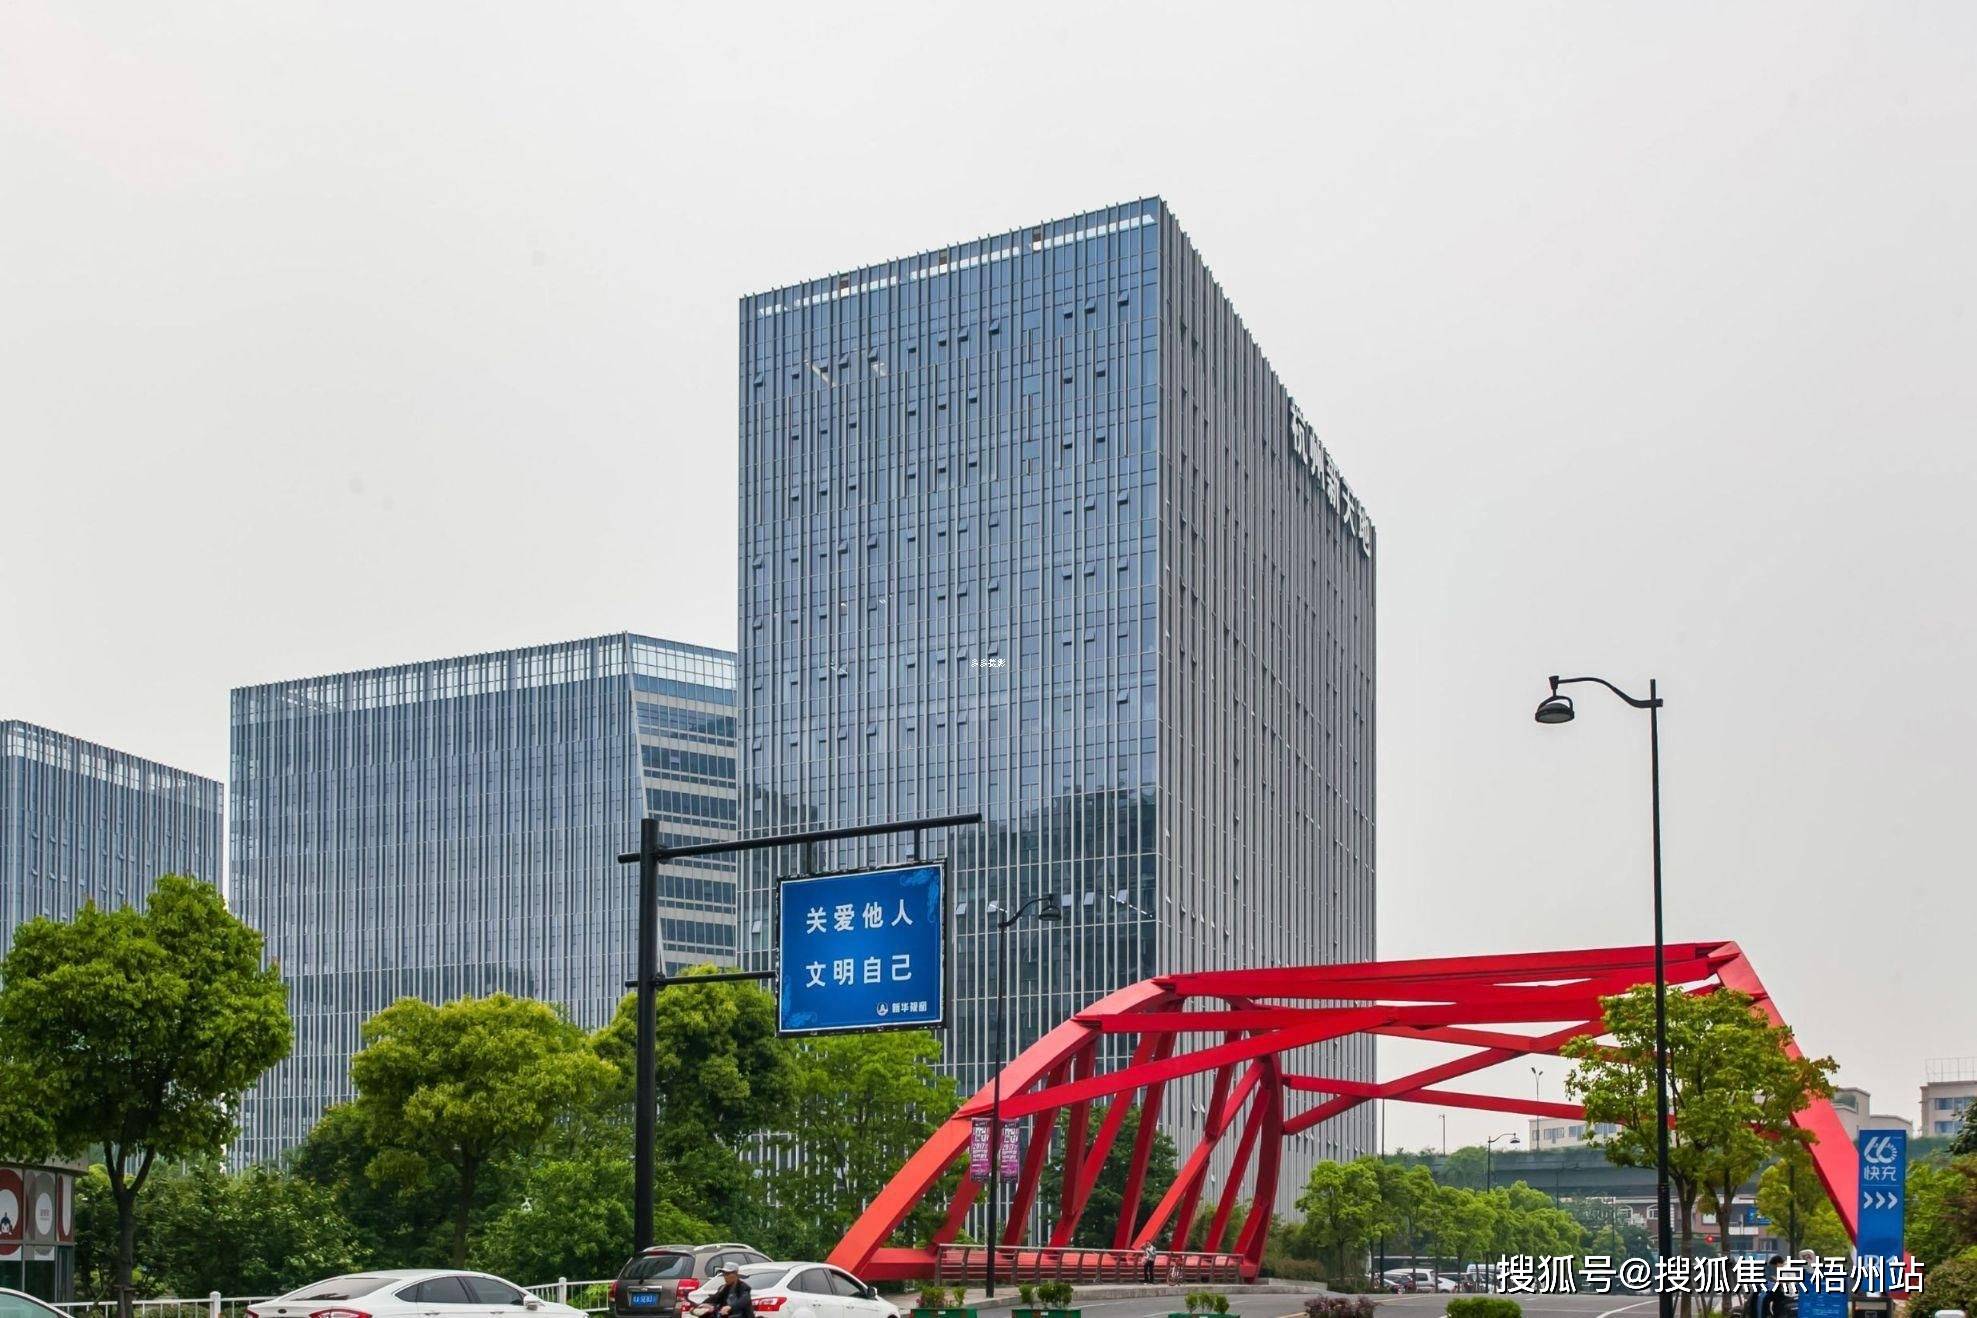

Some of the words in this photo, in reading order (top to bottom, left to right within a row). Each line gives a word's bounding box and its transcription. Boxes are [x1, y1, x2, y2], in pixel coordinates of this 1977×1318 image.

[806, 899, 913, 934] 关爱他人
[806, 954, 912, 988] 文明自己
[1864, 1166, 1897, 1182] 快充
